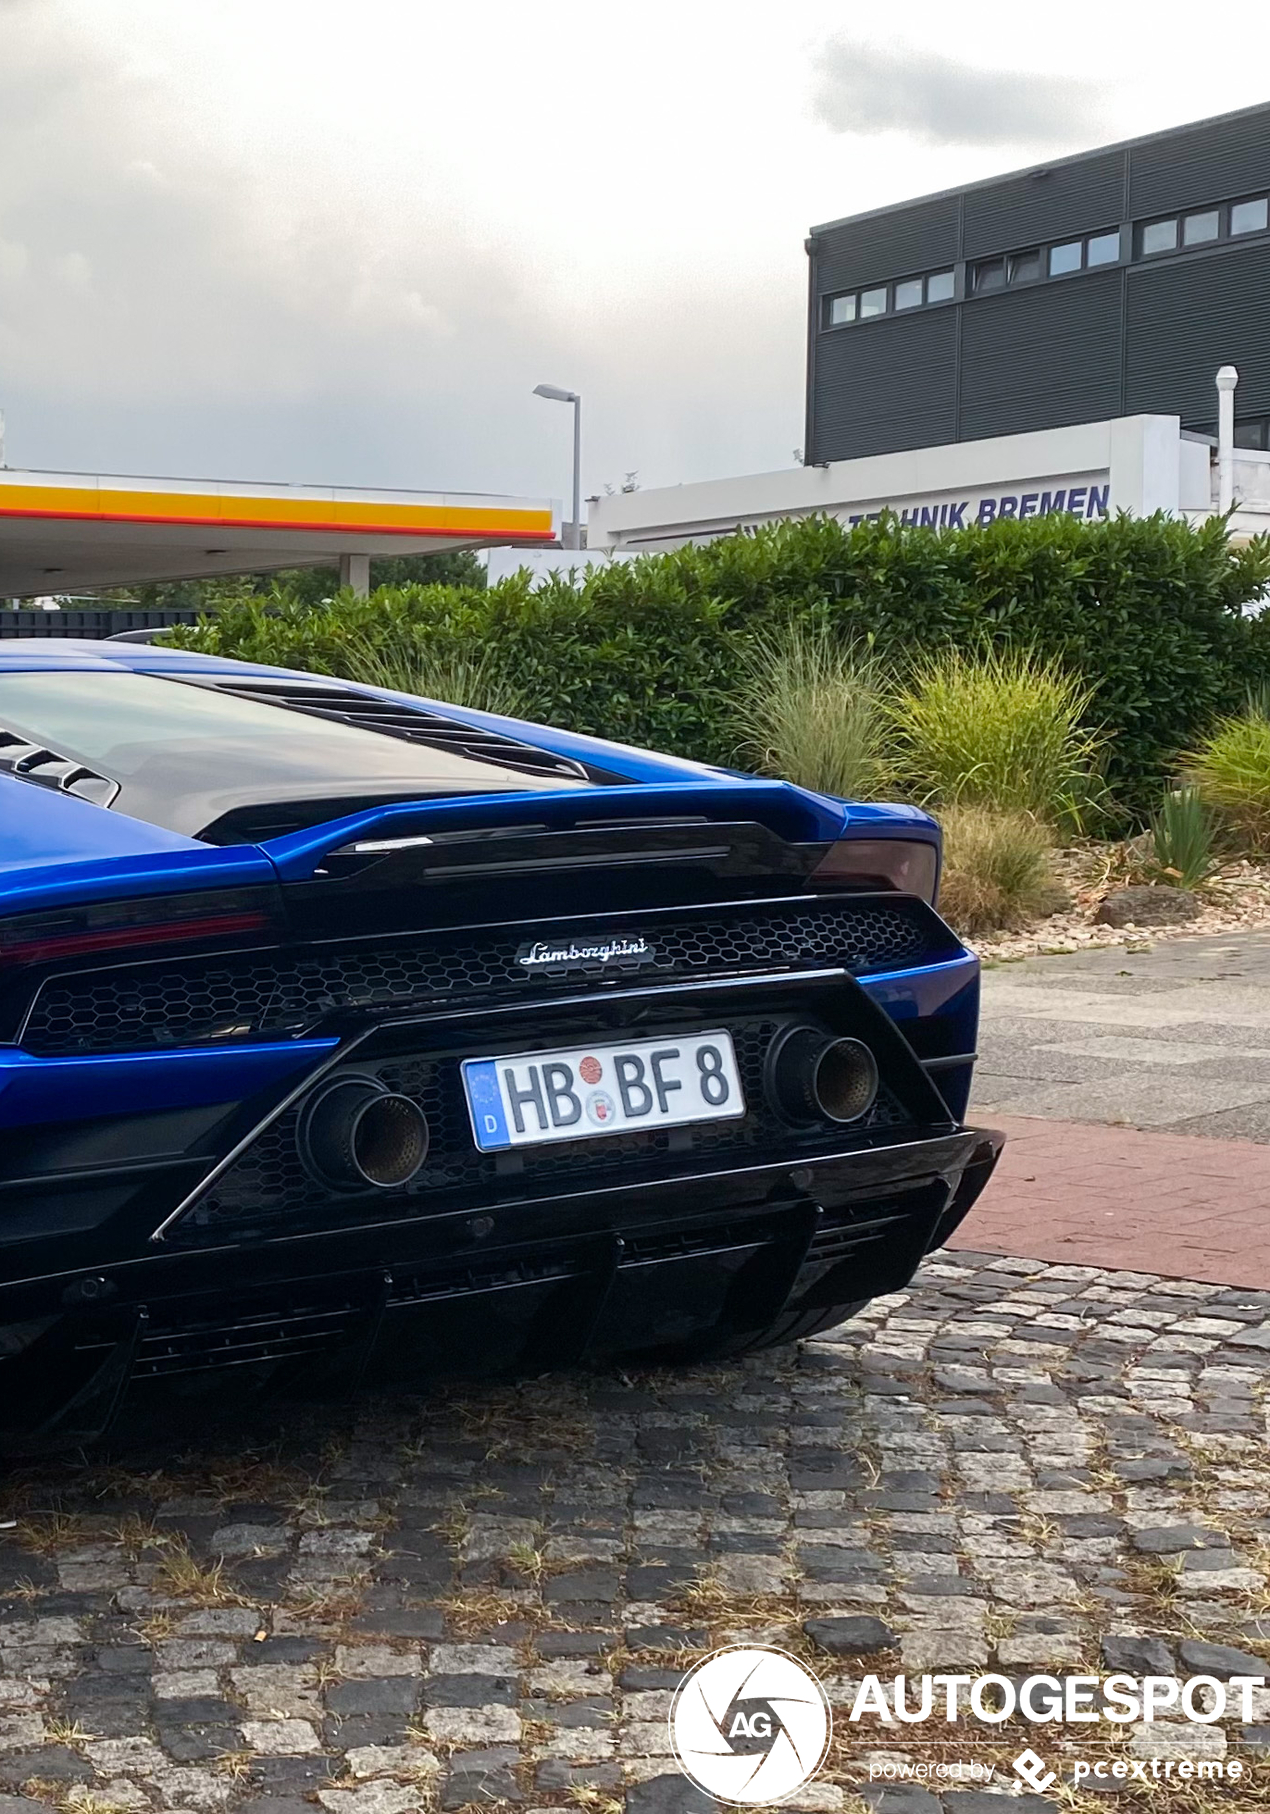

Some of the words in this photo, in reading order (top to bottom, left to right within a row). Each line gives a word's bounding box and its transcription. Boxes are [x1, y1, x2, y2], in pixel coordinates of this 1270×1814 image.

[979, 486, 1110, 529] BREMEN
[519, 938, 649, 965] Lamborghini
[504, 1062, 582, 1133] HB
[613, 1048, 682, 1118] BF
[696, 1044, 729, 1106] 8
[485, 1114, 498, 1134] D
